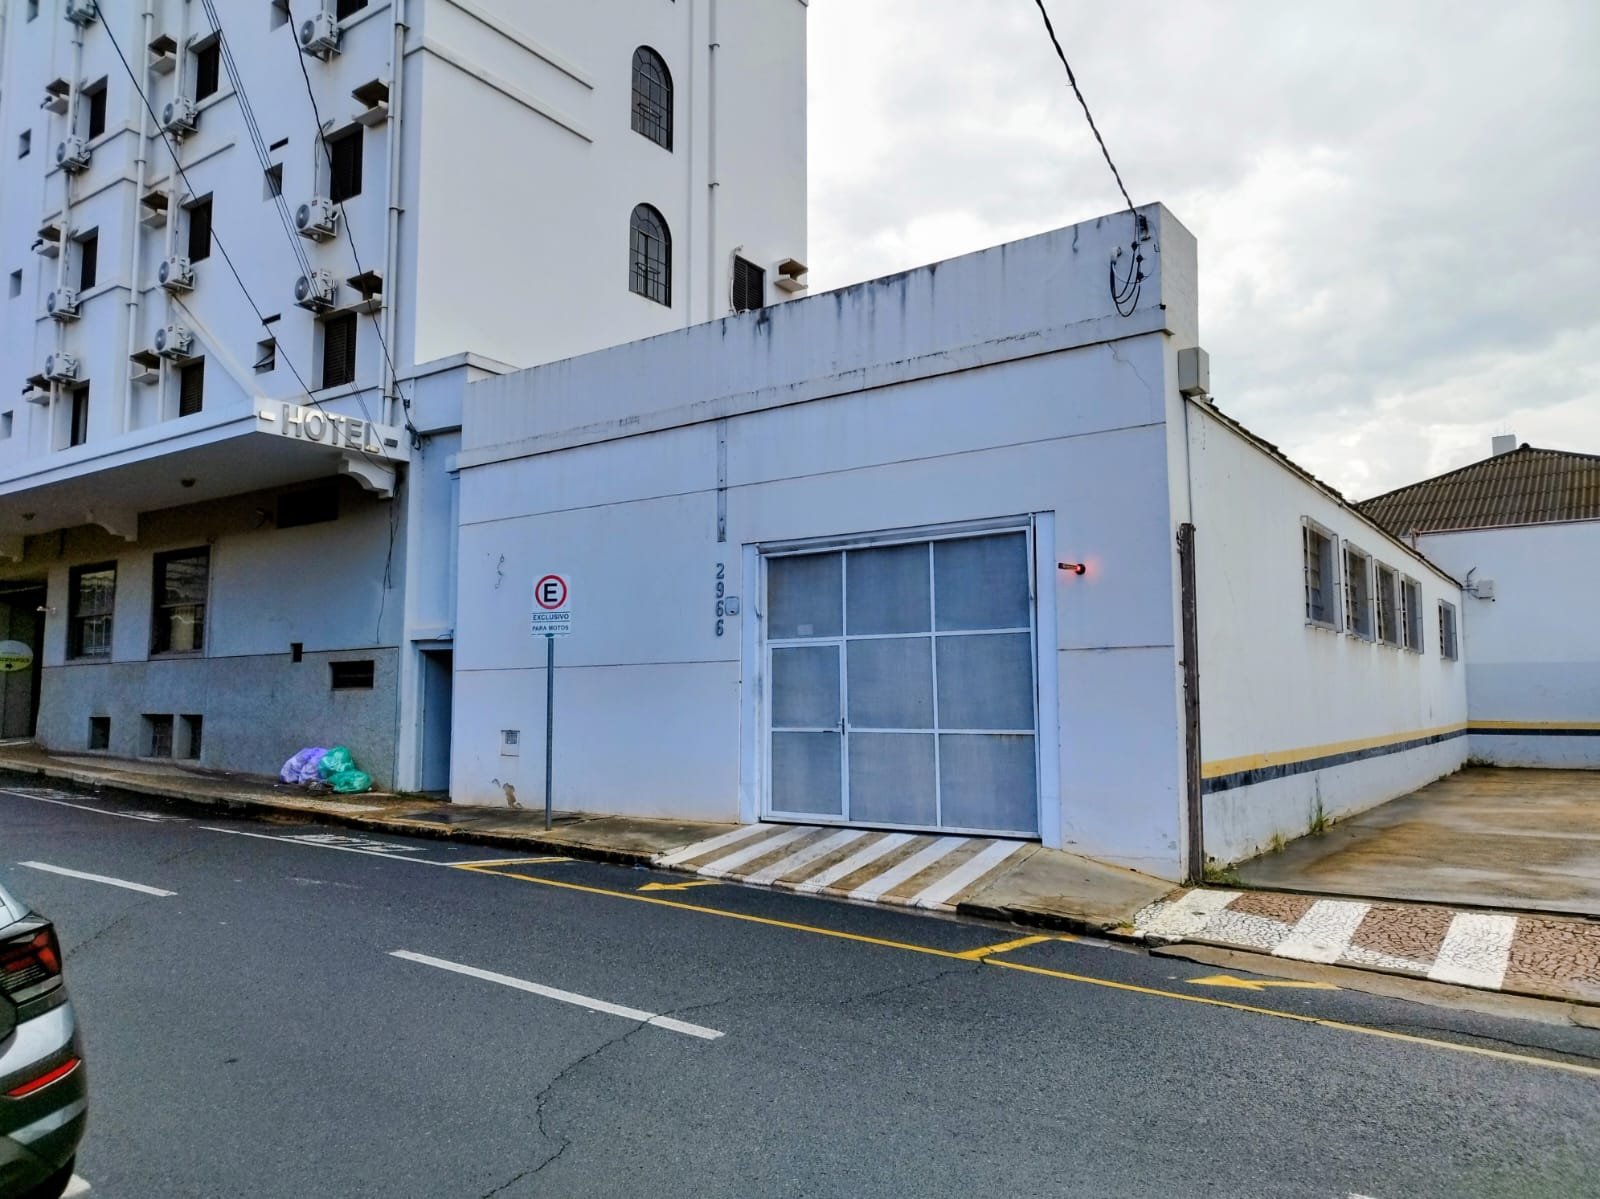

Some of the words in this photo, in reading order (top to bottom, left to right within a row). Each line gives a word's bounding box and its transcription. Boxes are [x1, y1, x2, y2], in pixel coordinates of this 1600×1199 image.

[282, 404, 380, 453] HOTEL
[544, 583, 558, 602] E
[715, 562, 725, 637] 2966
[533, 613, 569, 621] EXCLUSIVO
